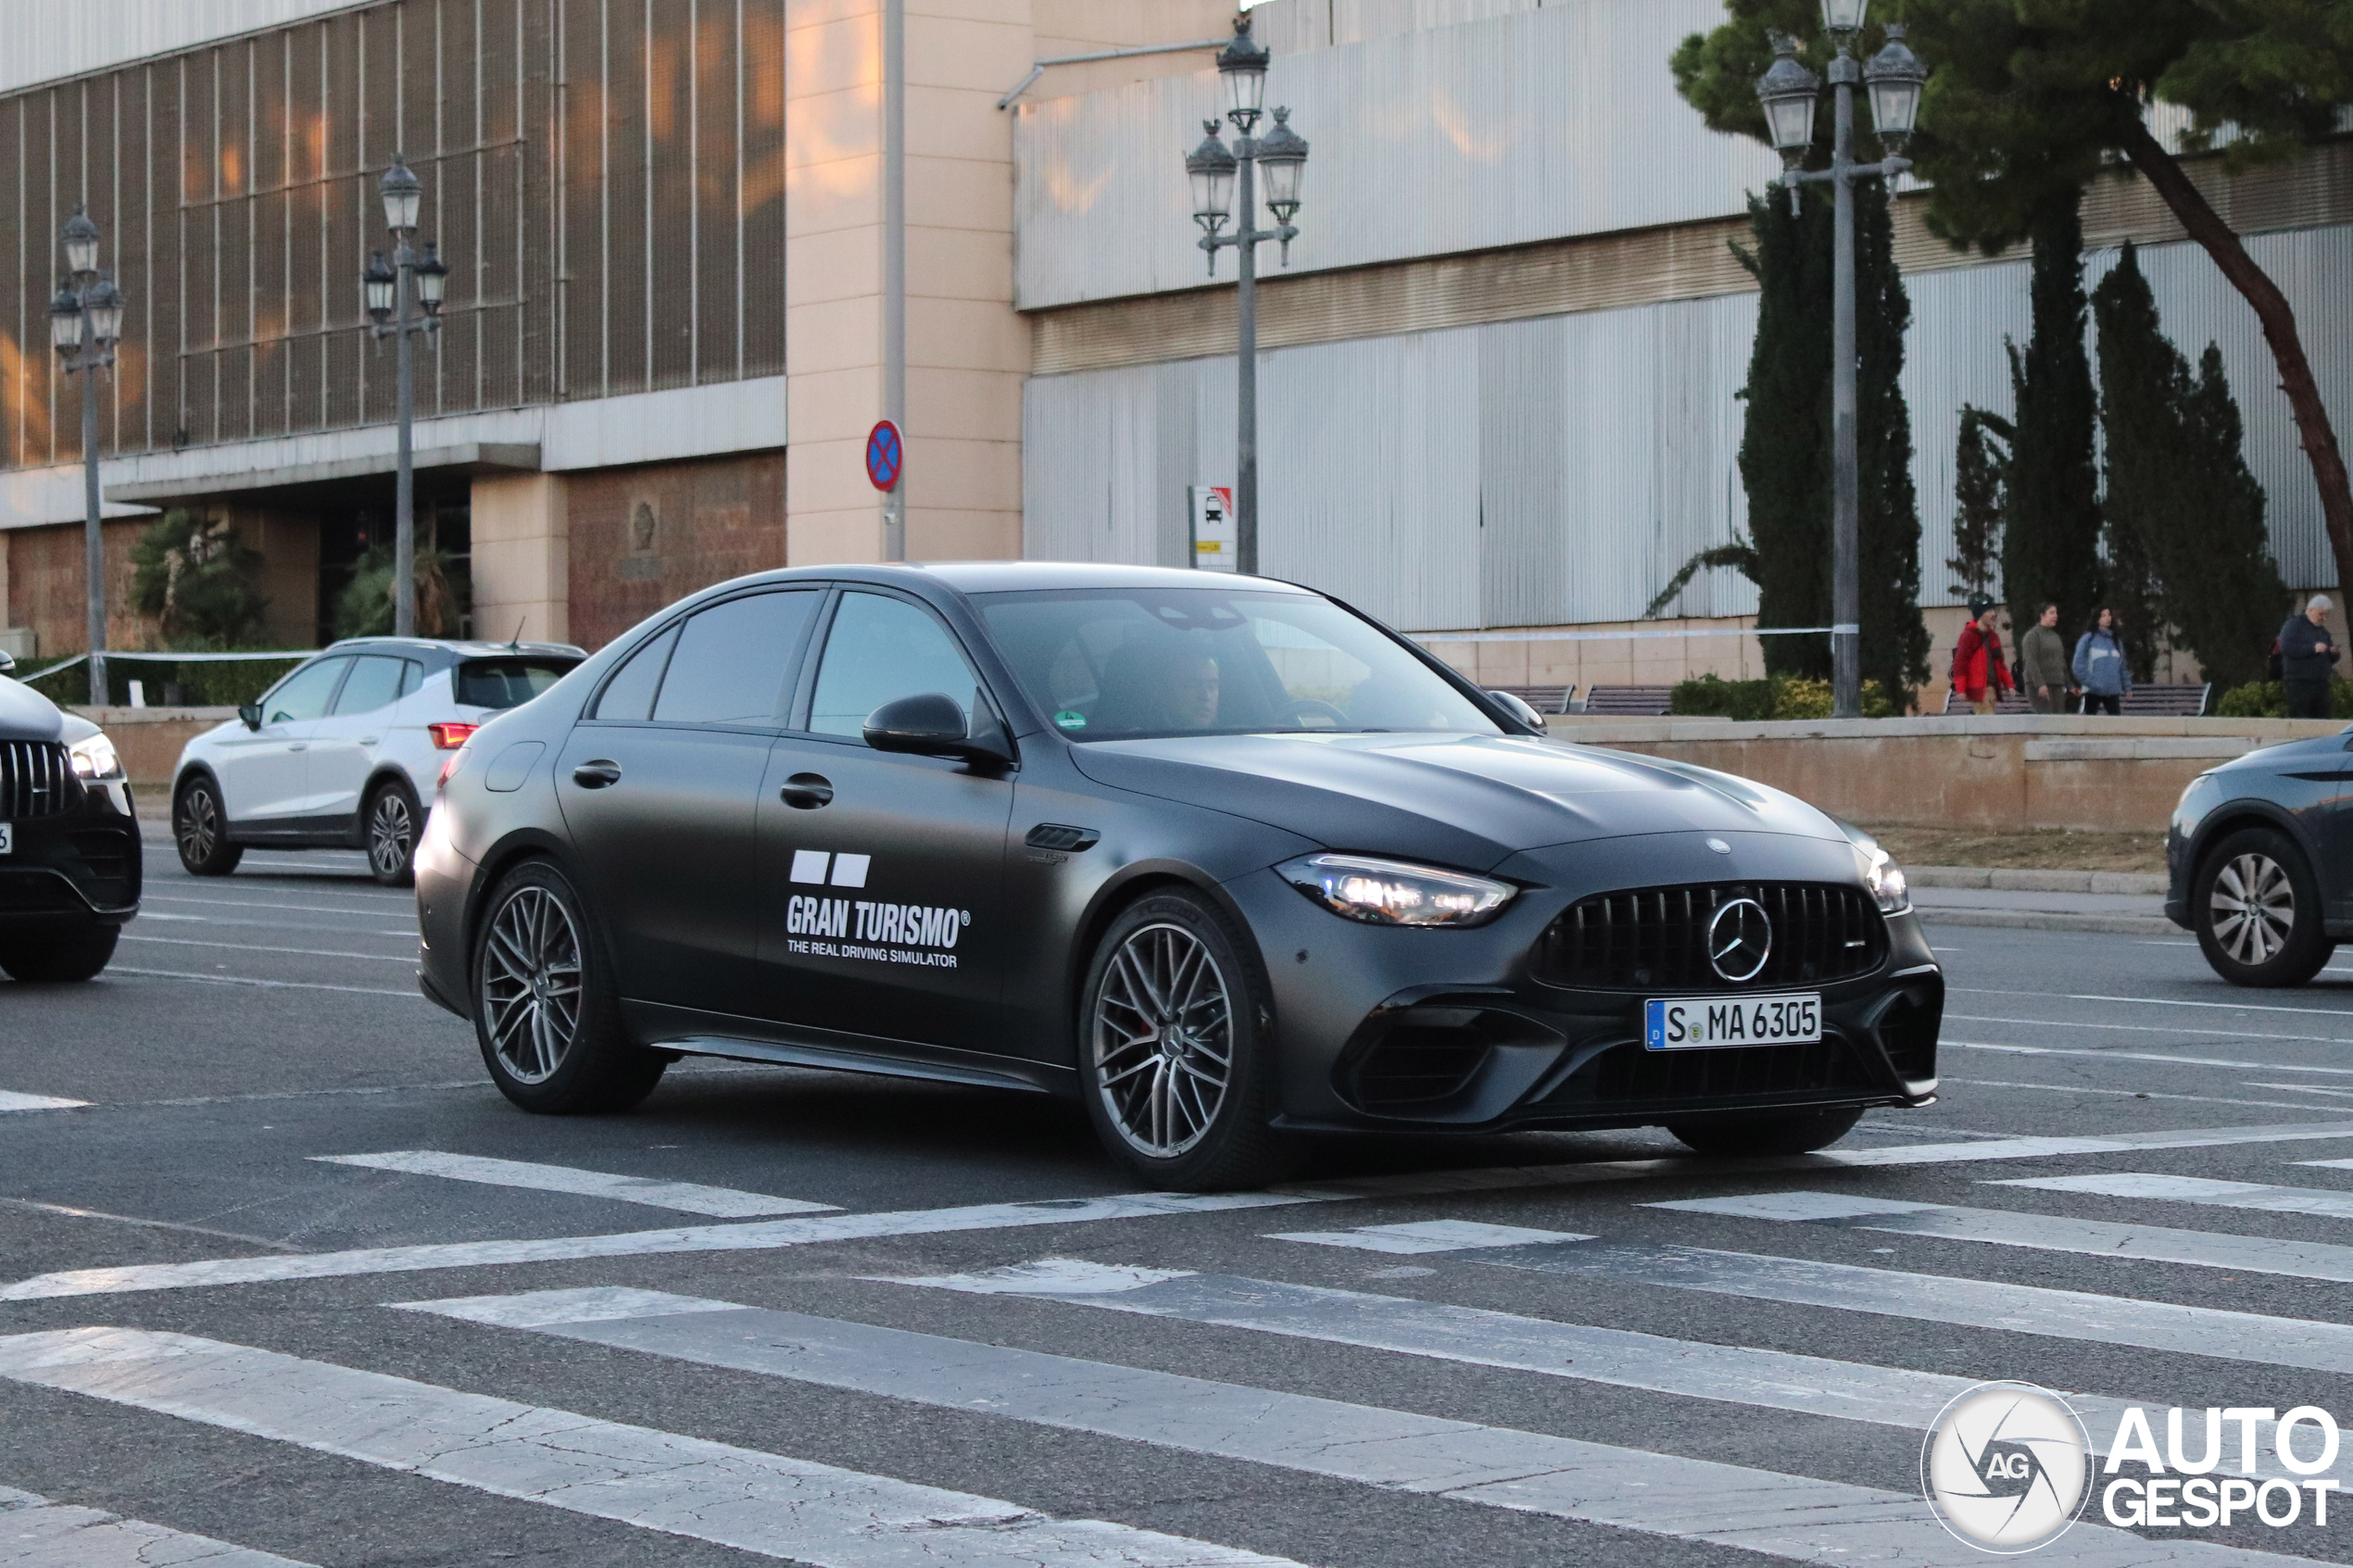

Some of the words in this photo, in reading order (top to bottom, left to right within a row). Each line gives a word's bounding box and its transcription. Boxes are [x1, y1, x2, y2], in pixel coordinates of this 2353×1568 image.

[786, 895, 849, 938] GRAN
[787, 939, 810, 954] THE
[811, 942, 840, 957] REAL
[841, 945, 888, 961] DRIVING
[889, 949, 958, 969] SIMULATOR
[1652, 1029, 1661, 1041] D
[1667, 1007, 1686, 1042] S
[1708, 1004, 1745, 1040] MA
[1752, 1000, 1817, 1038] 6305
